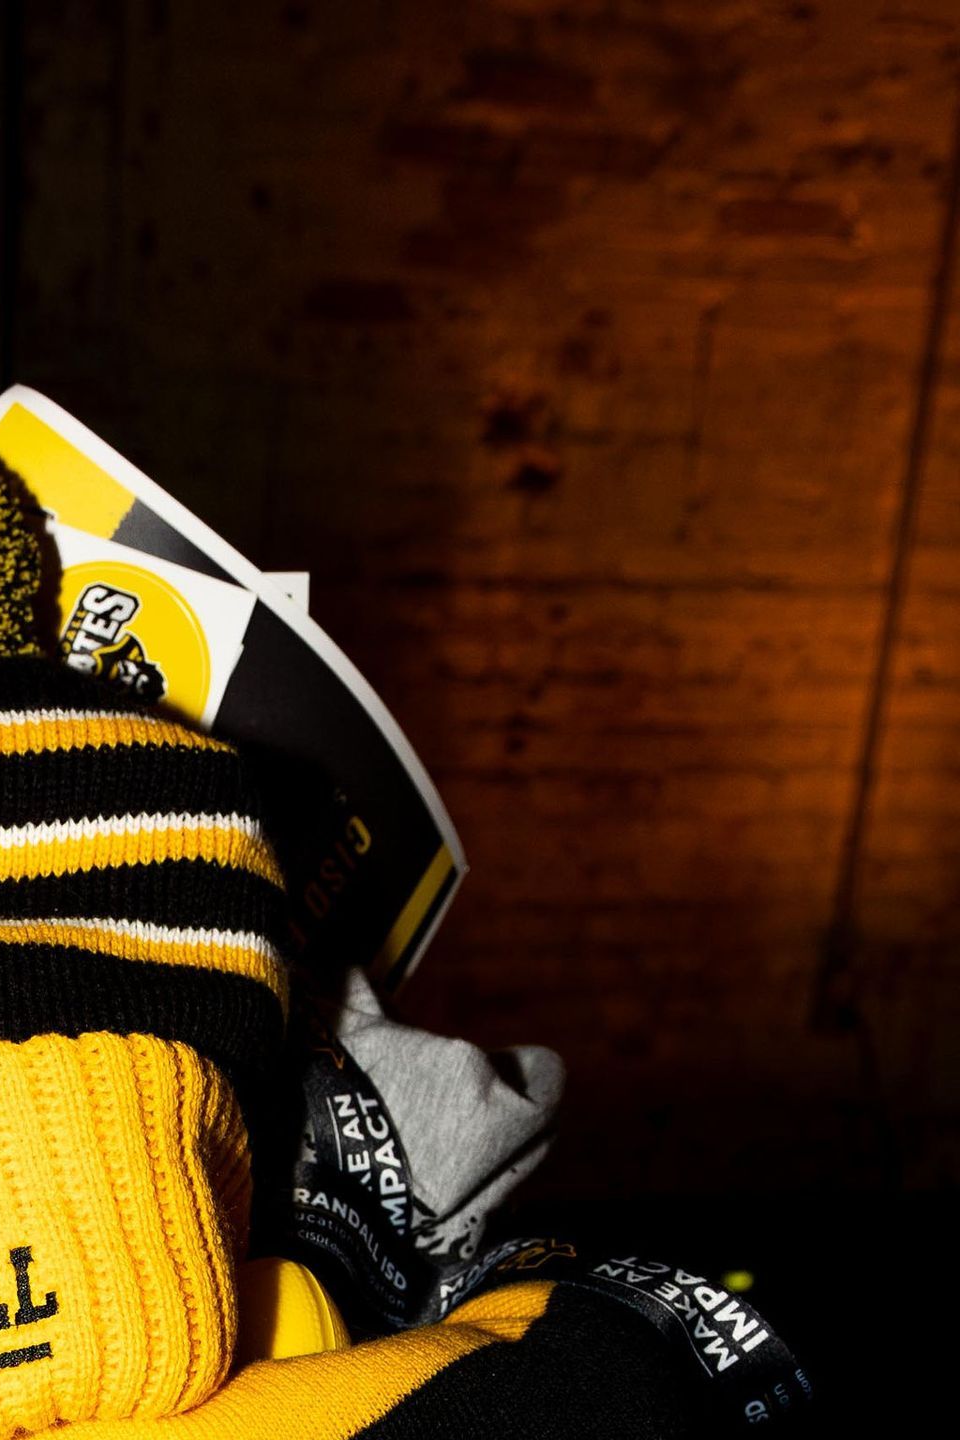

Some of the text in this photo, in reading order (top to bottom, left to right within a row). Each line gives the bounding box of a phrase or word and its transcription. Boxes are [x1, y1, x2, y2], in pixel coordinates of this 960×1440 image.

[66, 585, 137, 674] ATES
[355, 1091, 408, 1237] MPACT
[292, 1187, 379, 1263] RANDALL
[380, 1255, 408, 1291] ISD
[592, 1263, 656, 1284] AN
[609, 1256, 770, 1353] IMPACT
[653, 1281, 740, 1373] MAKE
